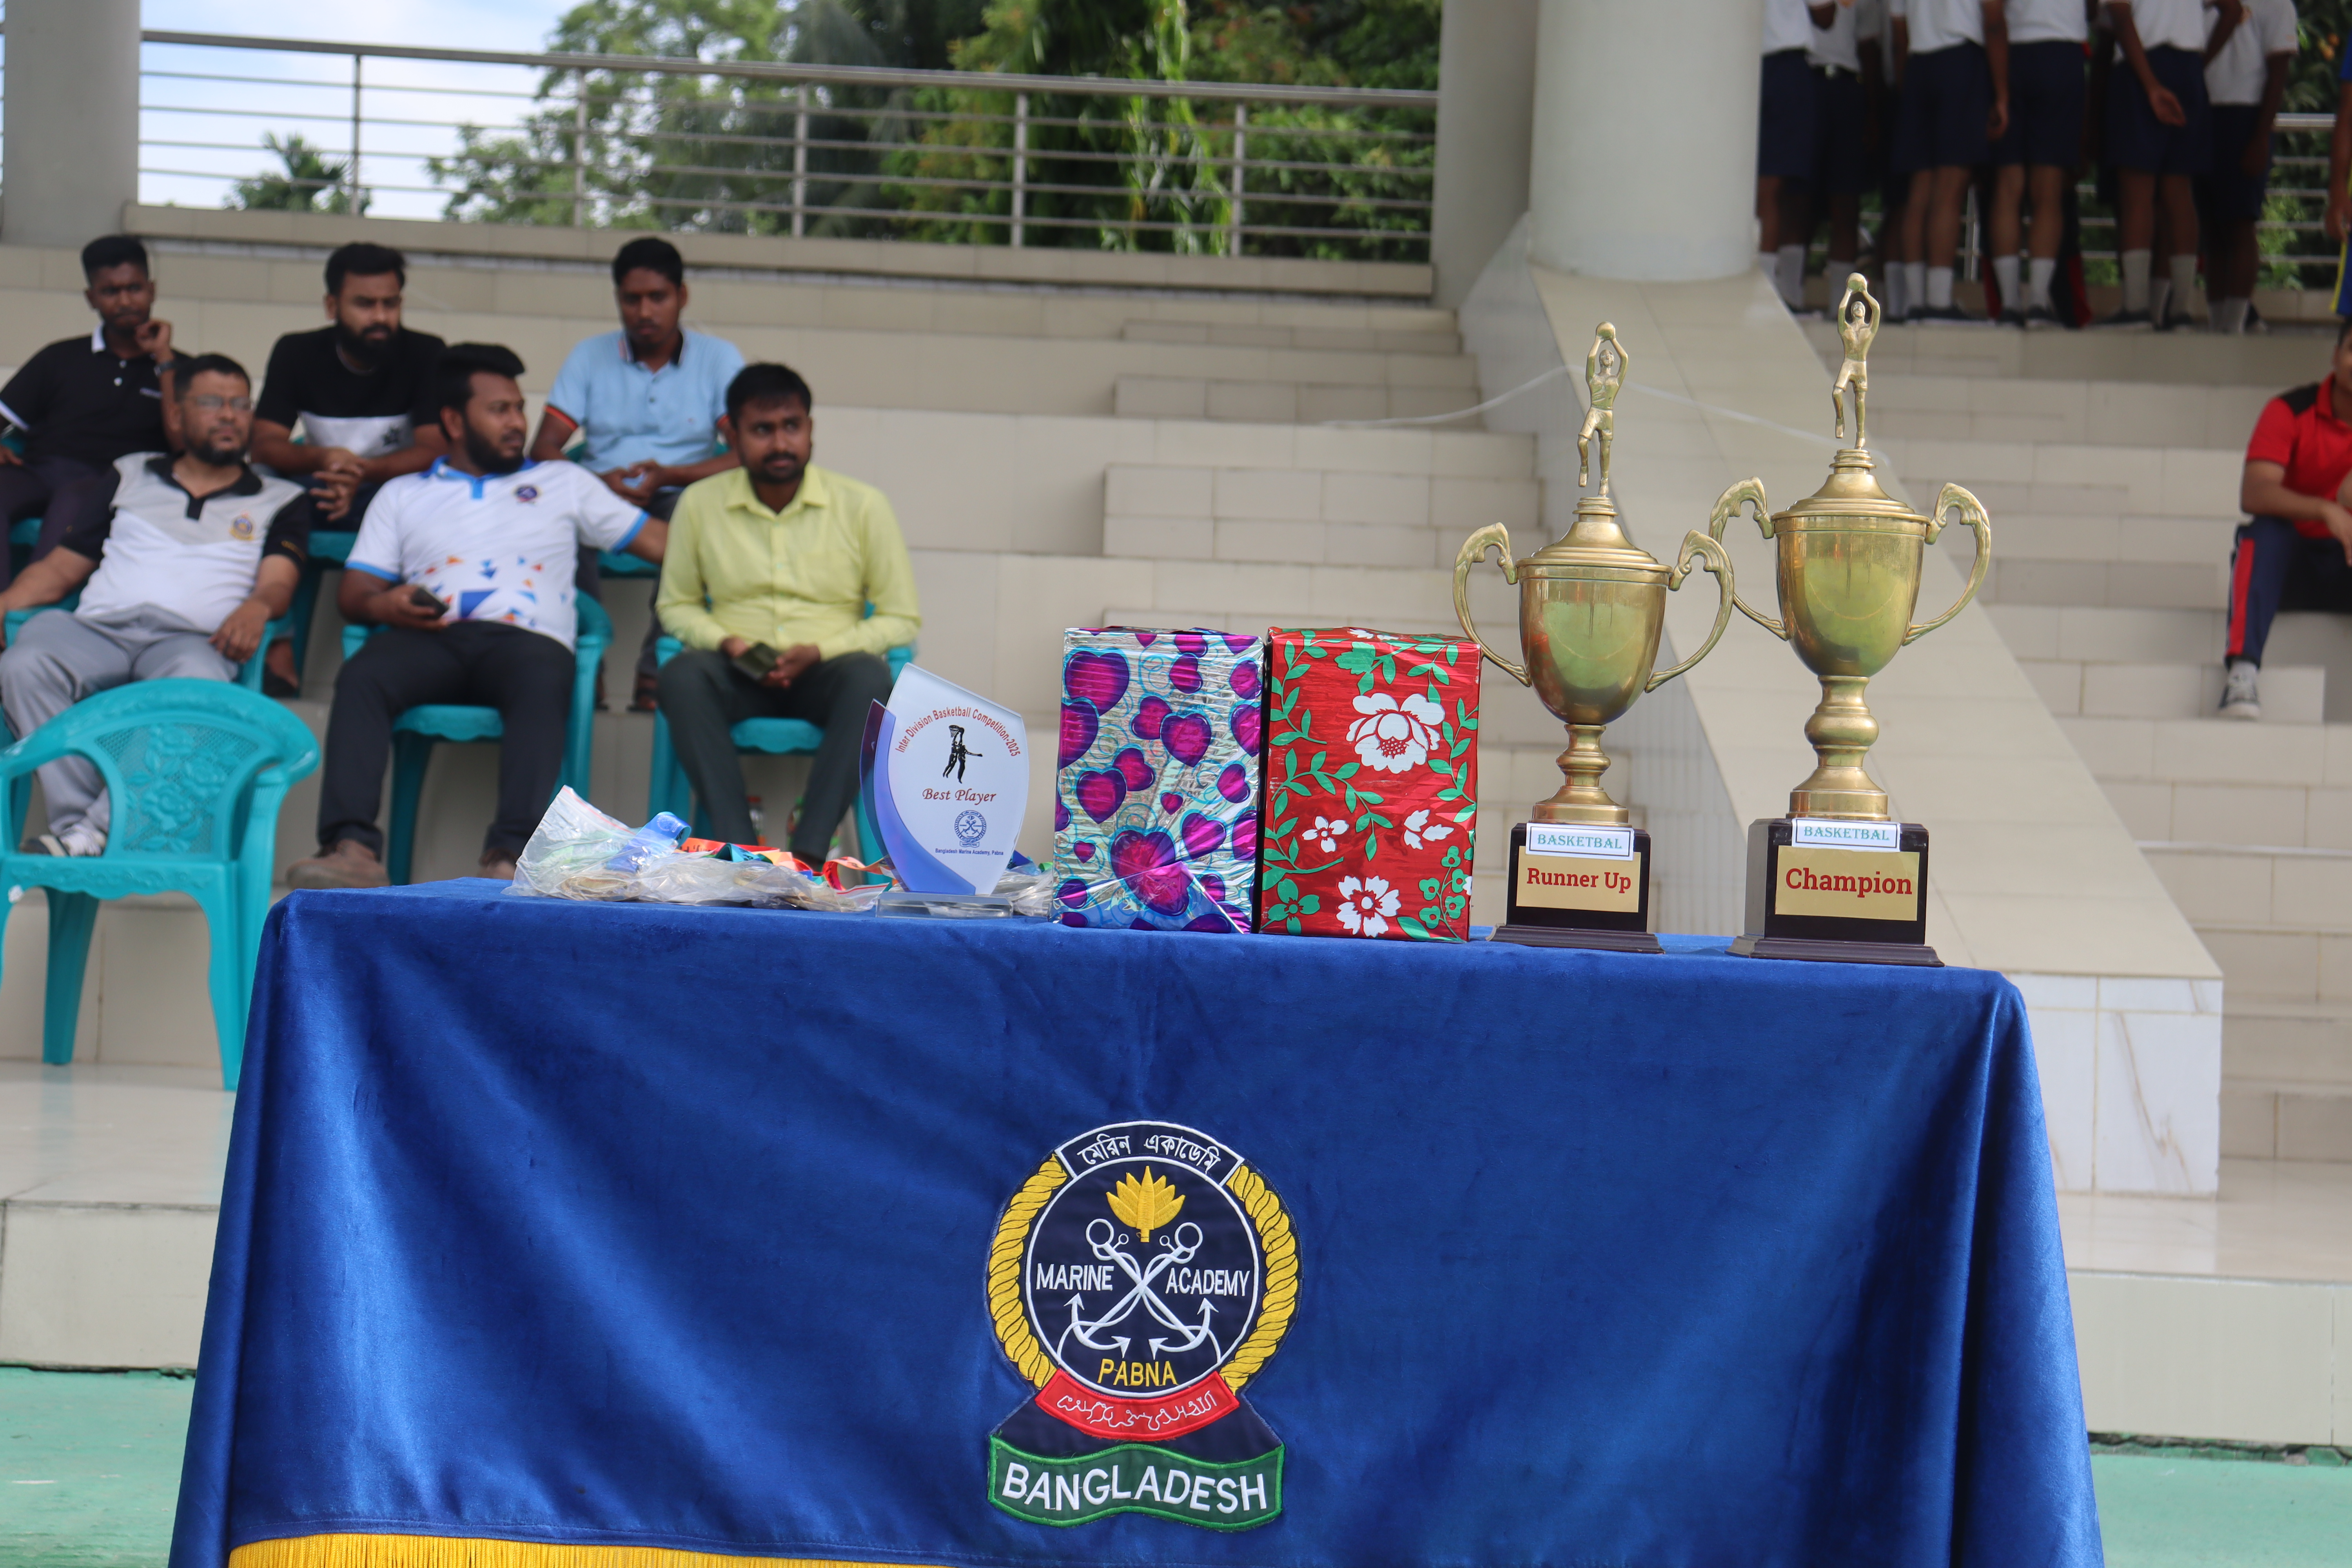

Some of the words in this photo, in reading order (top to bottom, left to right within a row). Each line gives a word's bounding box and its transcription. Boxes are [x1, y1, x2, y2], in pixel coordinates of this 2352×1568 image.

[895, 735, 911, 753] Inter
[905, 717, 933, 738] Division
[932, 706, 971, 720] Basketball
[922, 788, 951, 800] Best
[955, 788, 997, 806] Player
[1537, 834, 1623, 849] BASKETBAL
[1804, 826, 1890, 841] BASKETBAL
[1526, 867, 1599, 887] Runner
[1604, 872, 1631, 894] Up
[1786, 867, 1913, 898] Champion
[1076, 1133, 1131, 1165] মেরিন
[1036, 1263, 1114, 1291] MARINE
[1165, 1267, 1250, 1296] ACADEMY
[1098, 1358, 1177, 1387] PABNA
[1002, 1462, 1267, 1514] BANGLADESH
